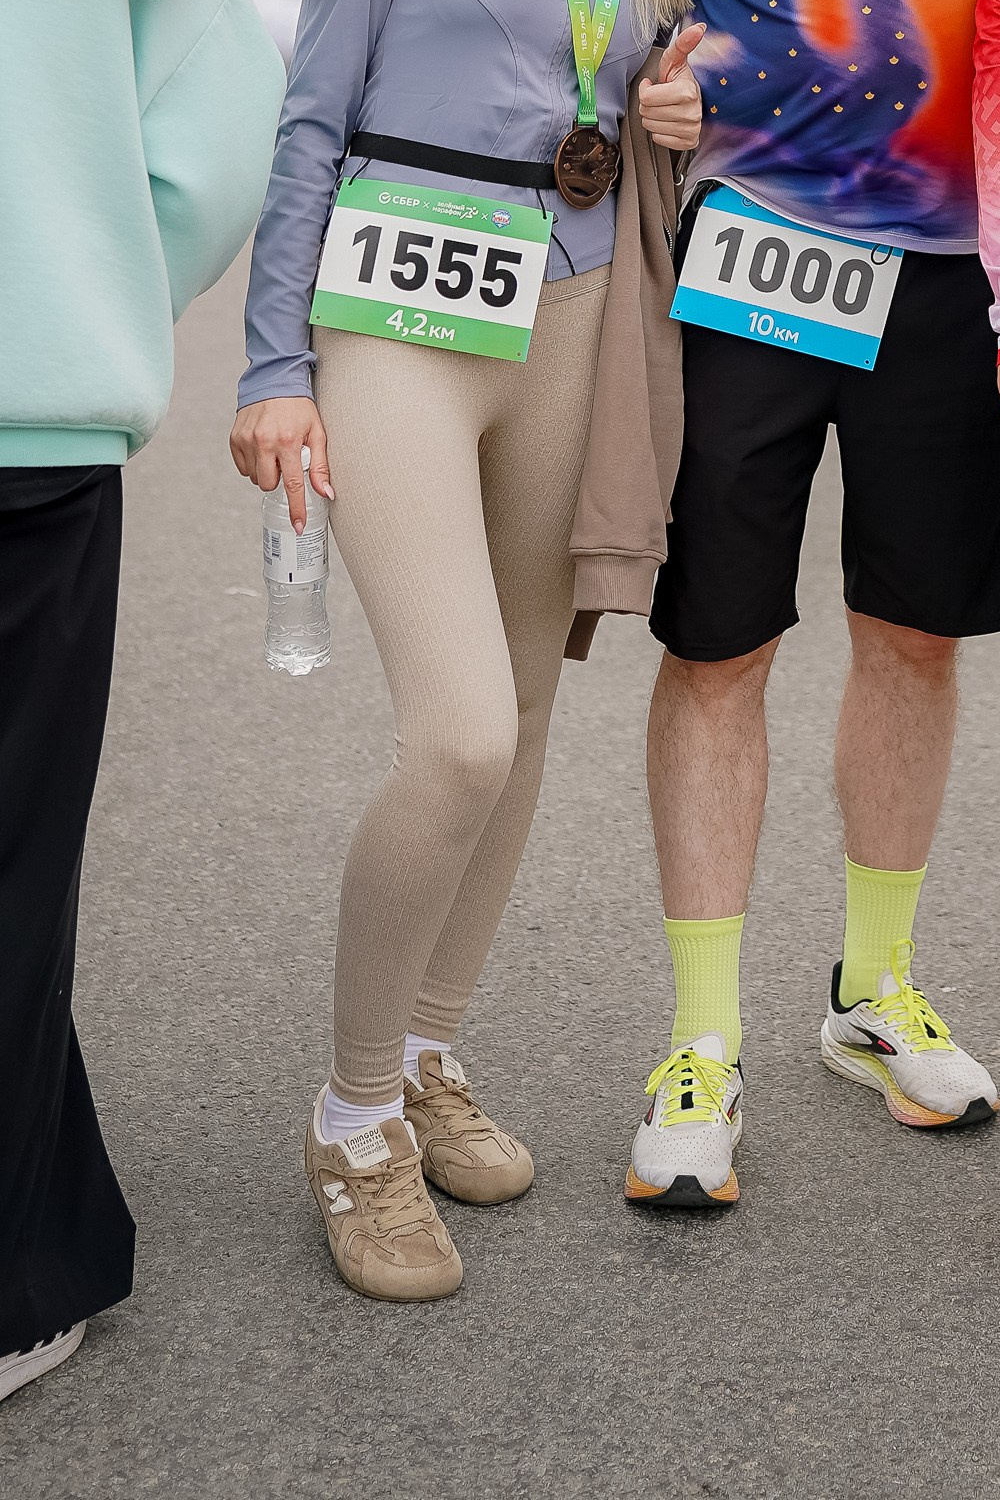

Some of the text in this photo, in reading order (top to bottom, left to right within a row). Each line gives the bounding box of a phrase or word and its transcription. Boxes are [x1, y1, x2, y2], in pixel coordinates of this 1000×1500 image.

[392, 195, 420, 207] СБЕР
[437, 201, 465, 212] зелёный
[432, 206, 462, 217] марафон
[352, 224, 523, 308] 1555
[715, 227, 874, 315] 1000
